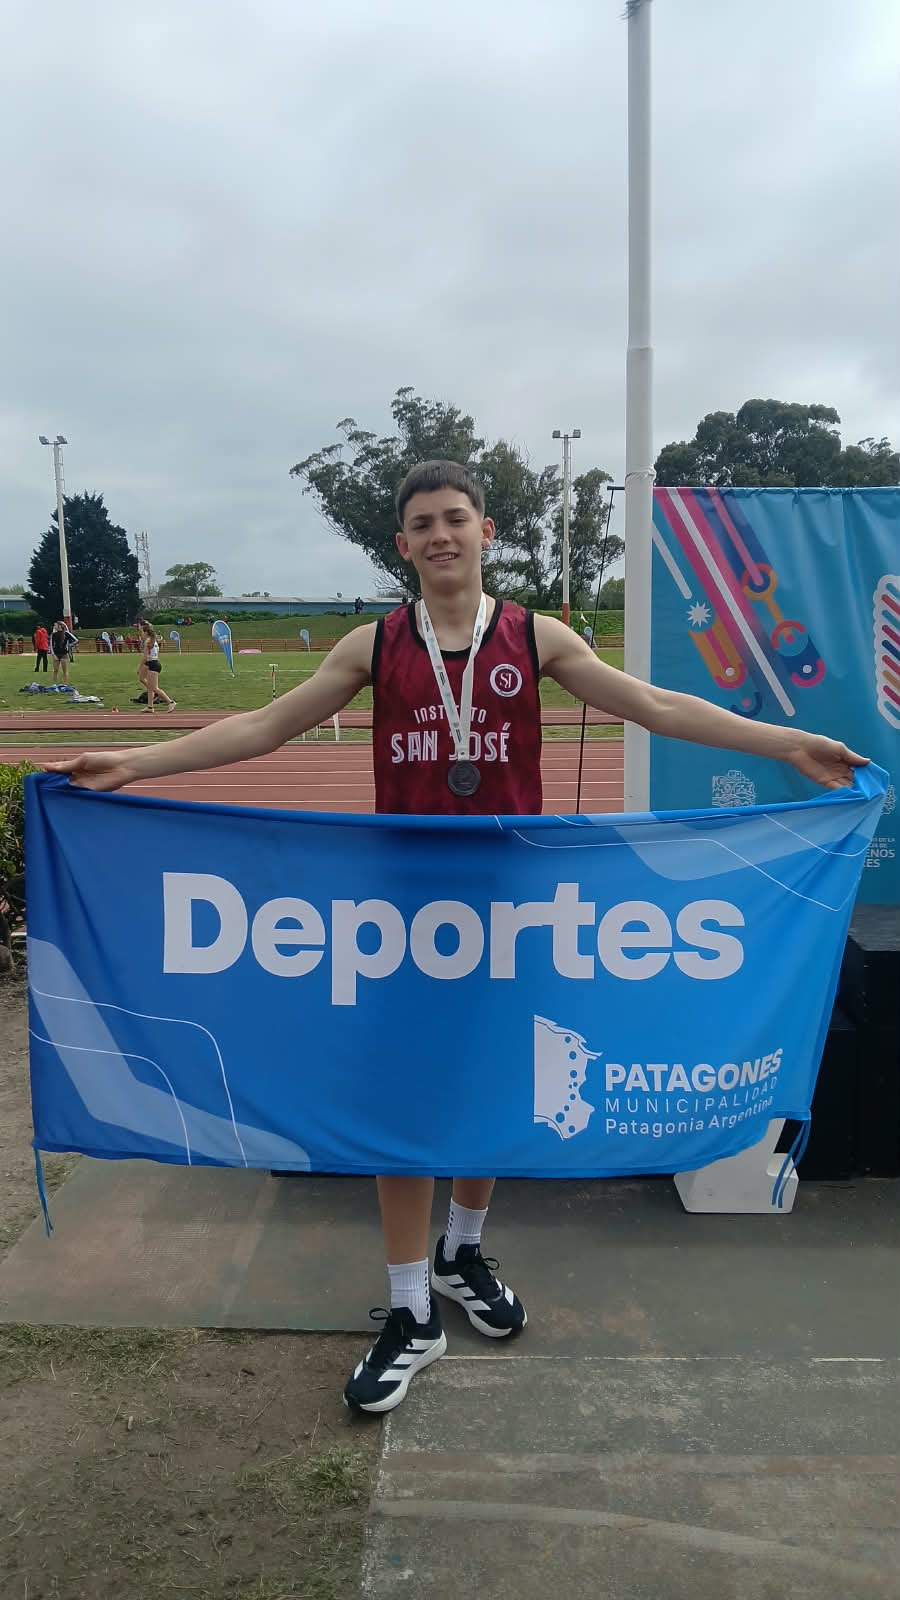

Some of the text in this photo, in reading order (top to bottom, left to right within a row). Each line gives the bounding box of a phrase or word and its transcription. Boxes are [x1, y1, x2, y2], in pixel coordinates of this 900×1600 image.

[414, 705, 487, 724] INSTTO
[391, 730, 438, 763] SAN
[866, 849, 896, 858] ENOS
[163, 872, 745, 1005] Deportes
[605, 1048, 783, 1092] PATAGONES
[605, 1076, 777, 1113] MUNICIPALIDAD
[606, 1096, 774, 1138] Patagonia Argentina
